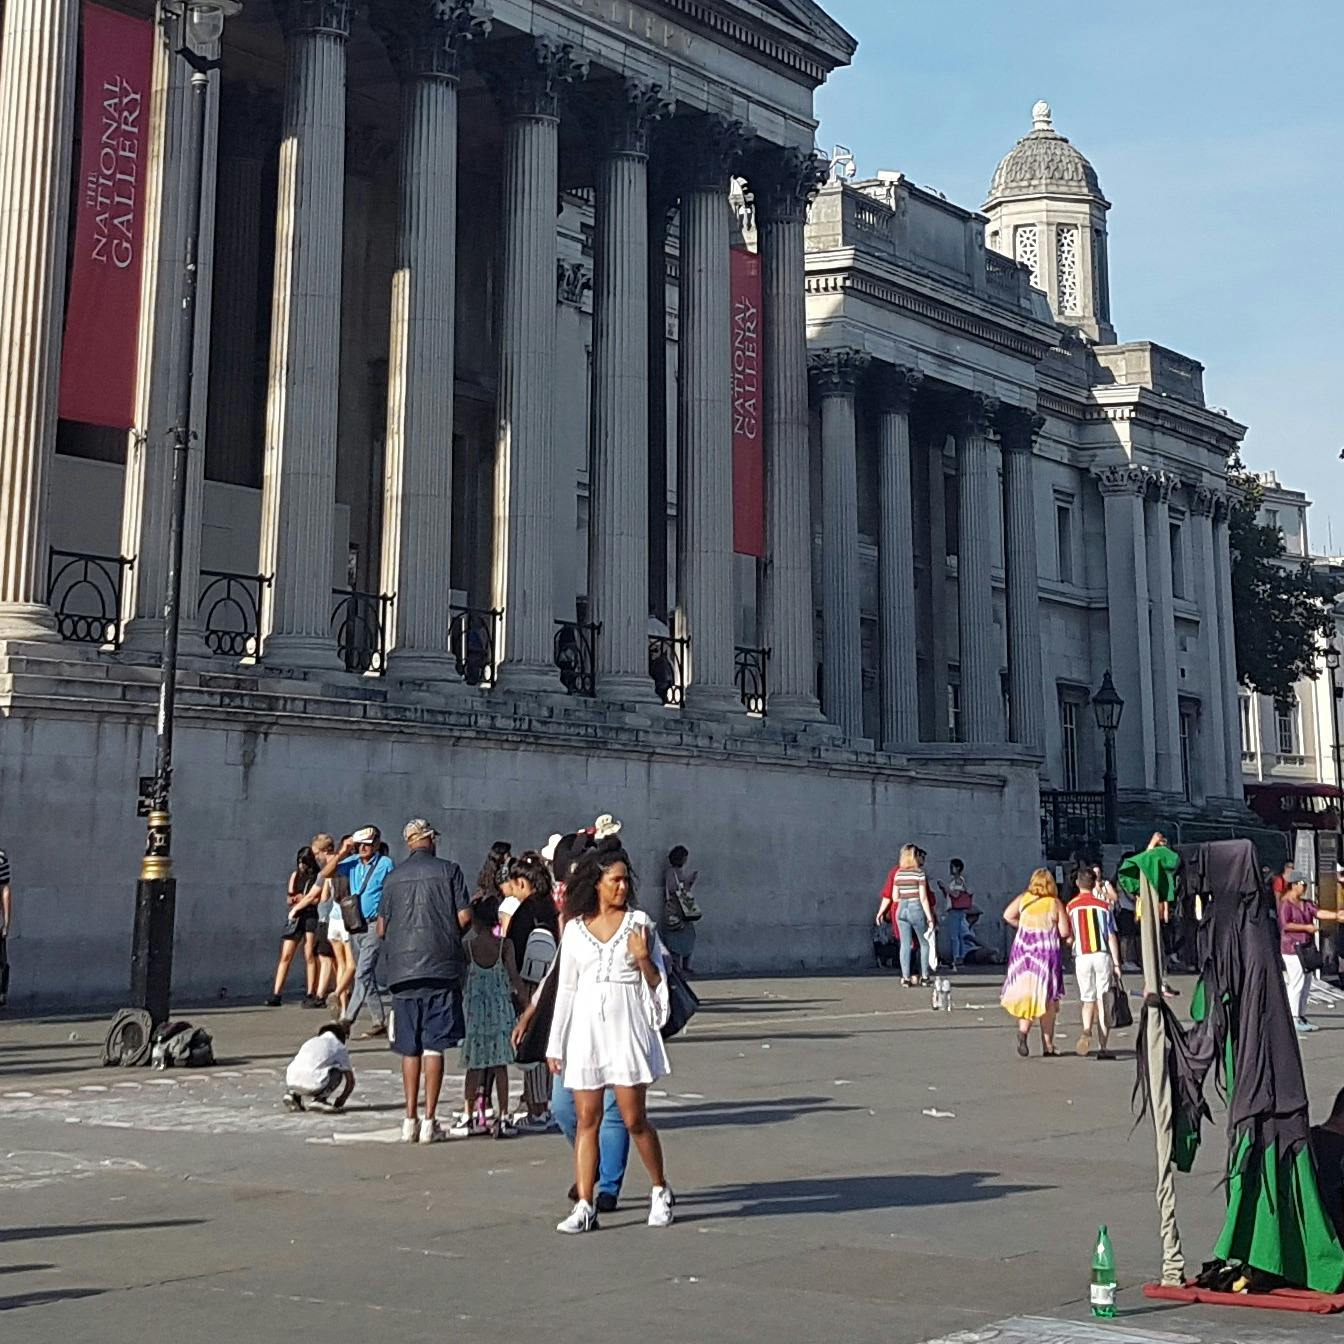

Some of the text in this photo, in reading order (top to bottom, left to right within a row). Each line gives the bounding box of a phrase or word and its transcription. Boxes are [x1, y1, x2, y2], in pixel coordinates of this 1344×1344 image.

[86, 170, 97, 208] THE
[91, 74, 121, 264] NATIONAL
[111, 78, 142, 268] GALLERY
[733, 295, 746, 435] NATIONAL
[743, 297, 758, 440] GALLERY
